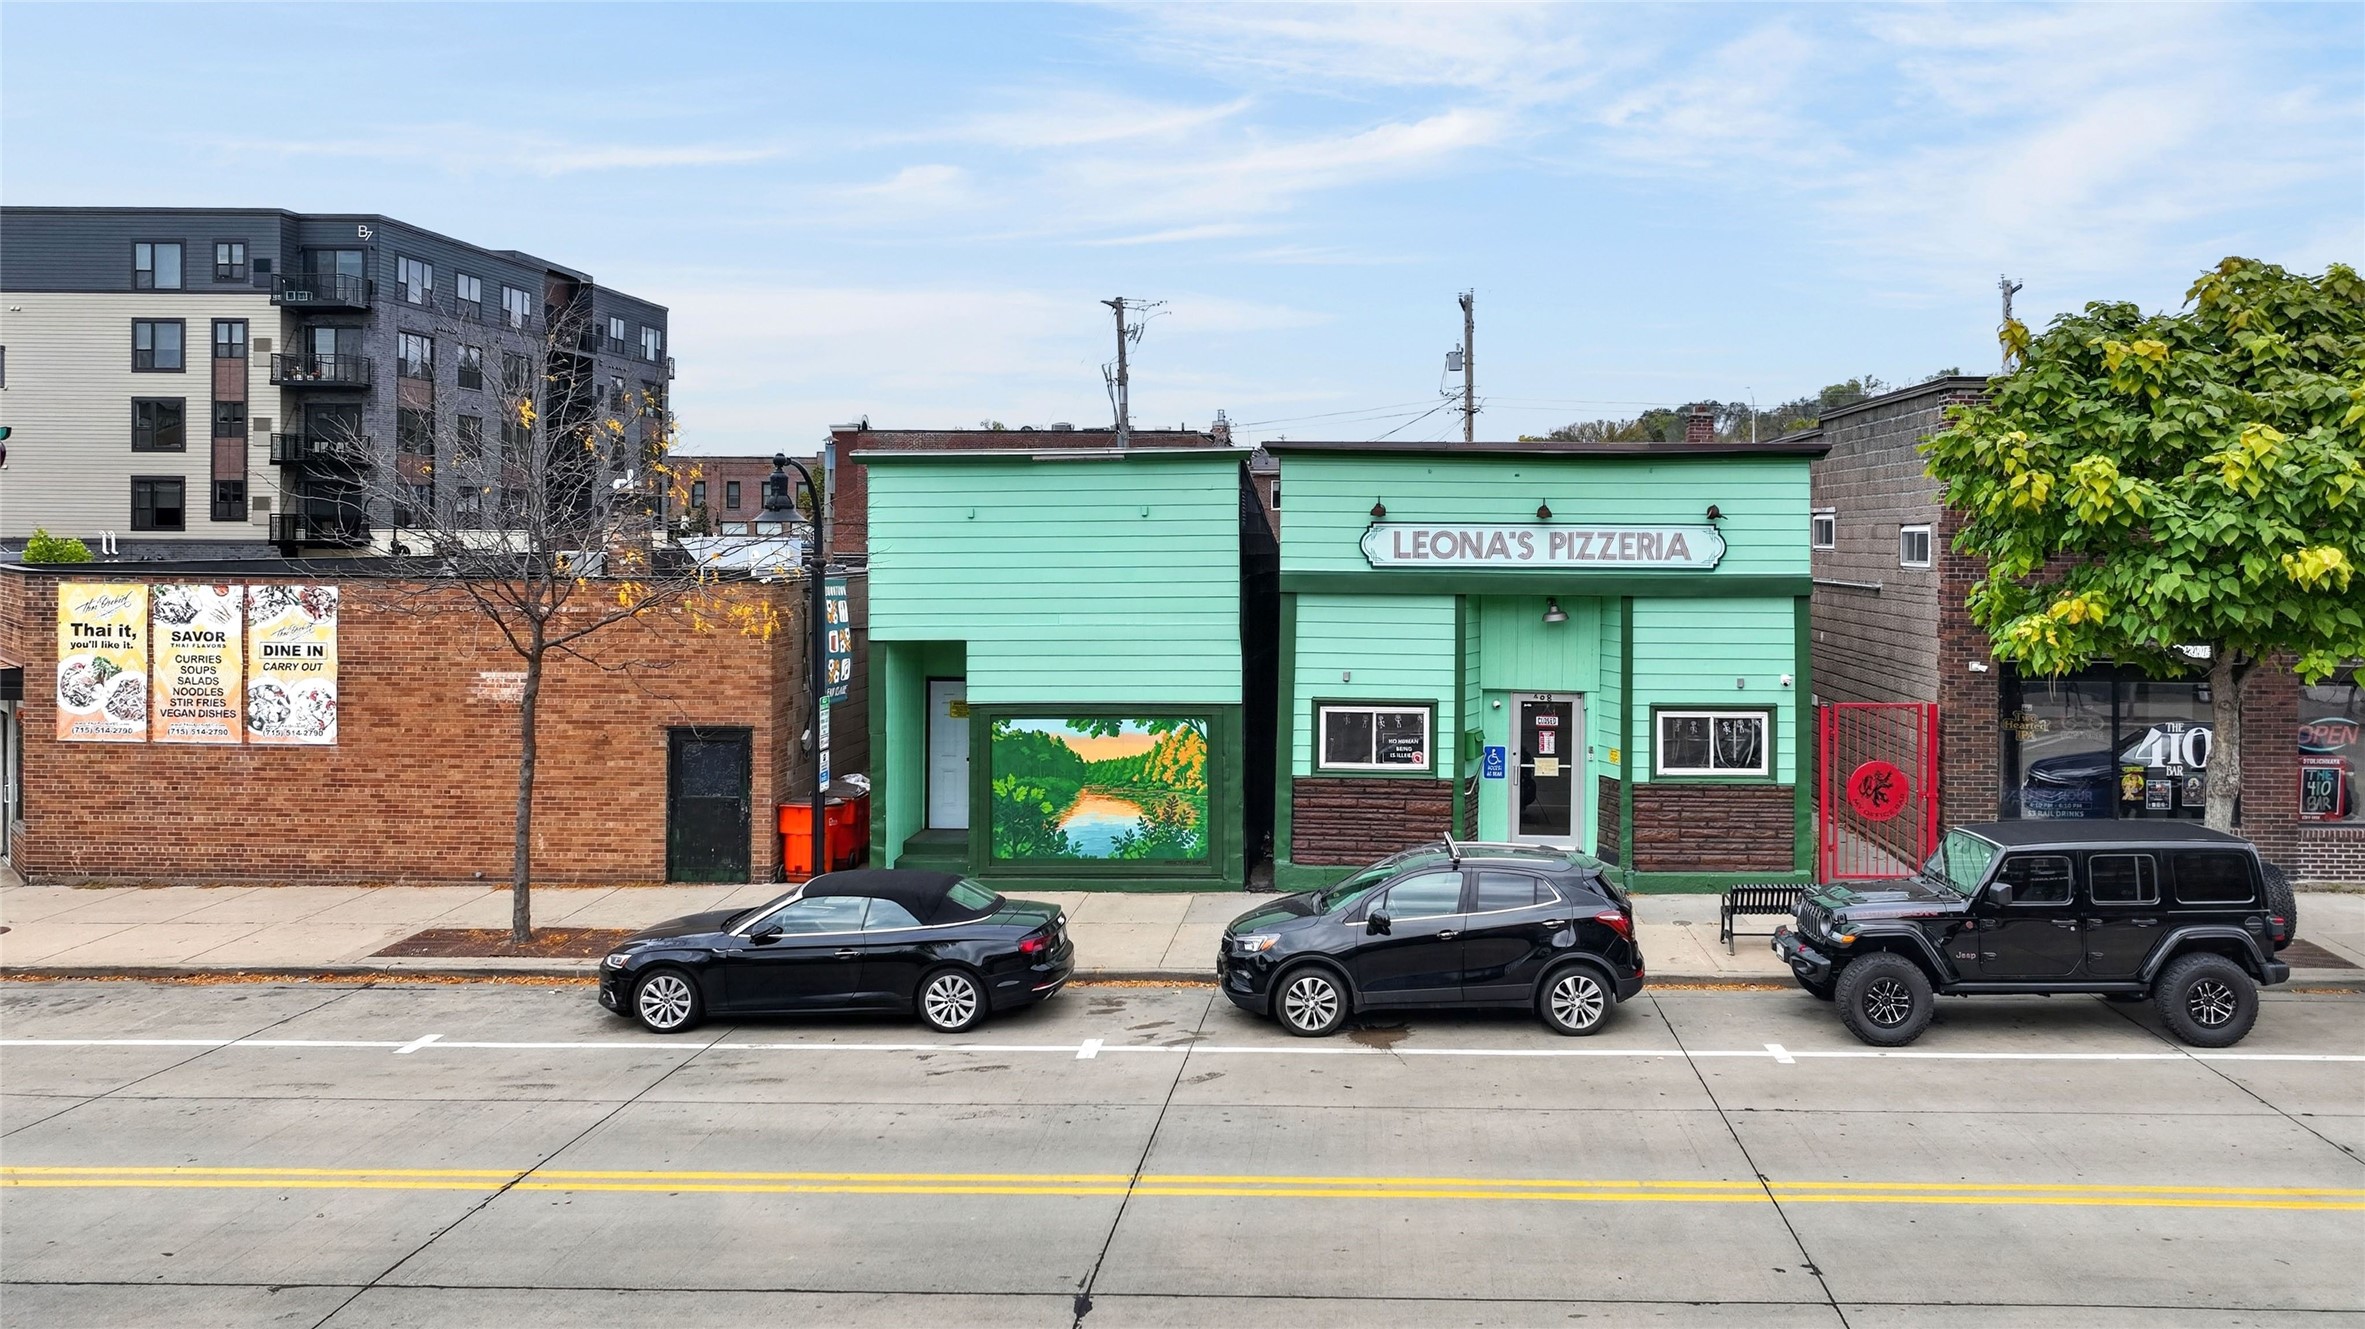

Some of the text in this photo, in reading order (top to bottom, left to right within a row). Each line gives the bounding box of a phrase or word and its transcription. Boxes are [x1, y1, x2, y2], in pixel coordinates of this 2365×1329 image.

[358, 224, 374, 241] B7
[1393, 530, 1693, 561] LEONA'S PIZZERIA
[70, 622, 137, 641] Thai it,
[171, 630, 226, 642] SAVOR
[70, 640, 134, 650] you'll like it.
[263, 644, 324, 657] DINE IN
[175, 654, 222, 664] CURRIES
[180, 665, 217, 675] SOUPS
[263, 662, 324, 672] CARRY OUT
[177, 676, 220, 686] SALADS
[172, 687, 224, 697] NOODLES
[169, 698, 227, 708] STIR FRIES
[160, 708, 237, 719] VEGAN DISHES
[2014, 711, 2038, 721] Two
[1537, 717, 1557, 725] CLOSED
[2004, 720, 2048, 731] Hearted
[71, 726, 133, 735] (715) 514-2790
[2165, 722, 2185, 733] THE
[262, 729, 284, 737] (715)
[2016, 730, 2034, 740] IPA
[2298, 725, 2360, 745] OPEN
[2135, 727, 2212, 768] 410
[2166, 765, 2184, 777] BAR
[2306, 769, 2335, 781] THE
[2307, 780, 2332, 796] 410
[2306, 795, 2332, 812] BAR
[1864, 809, 1893, 817] OFFICE
[1955, 951, 1977, 960] Jeep
